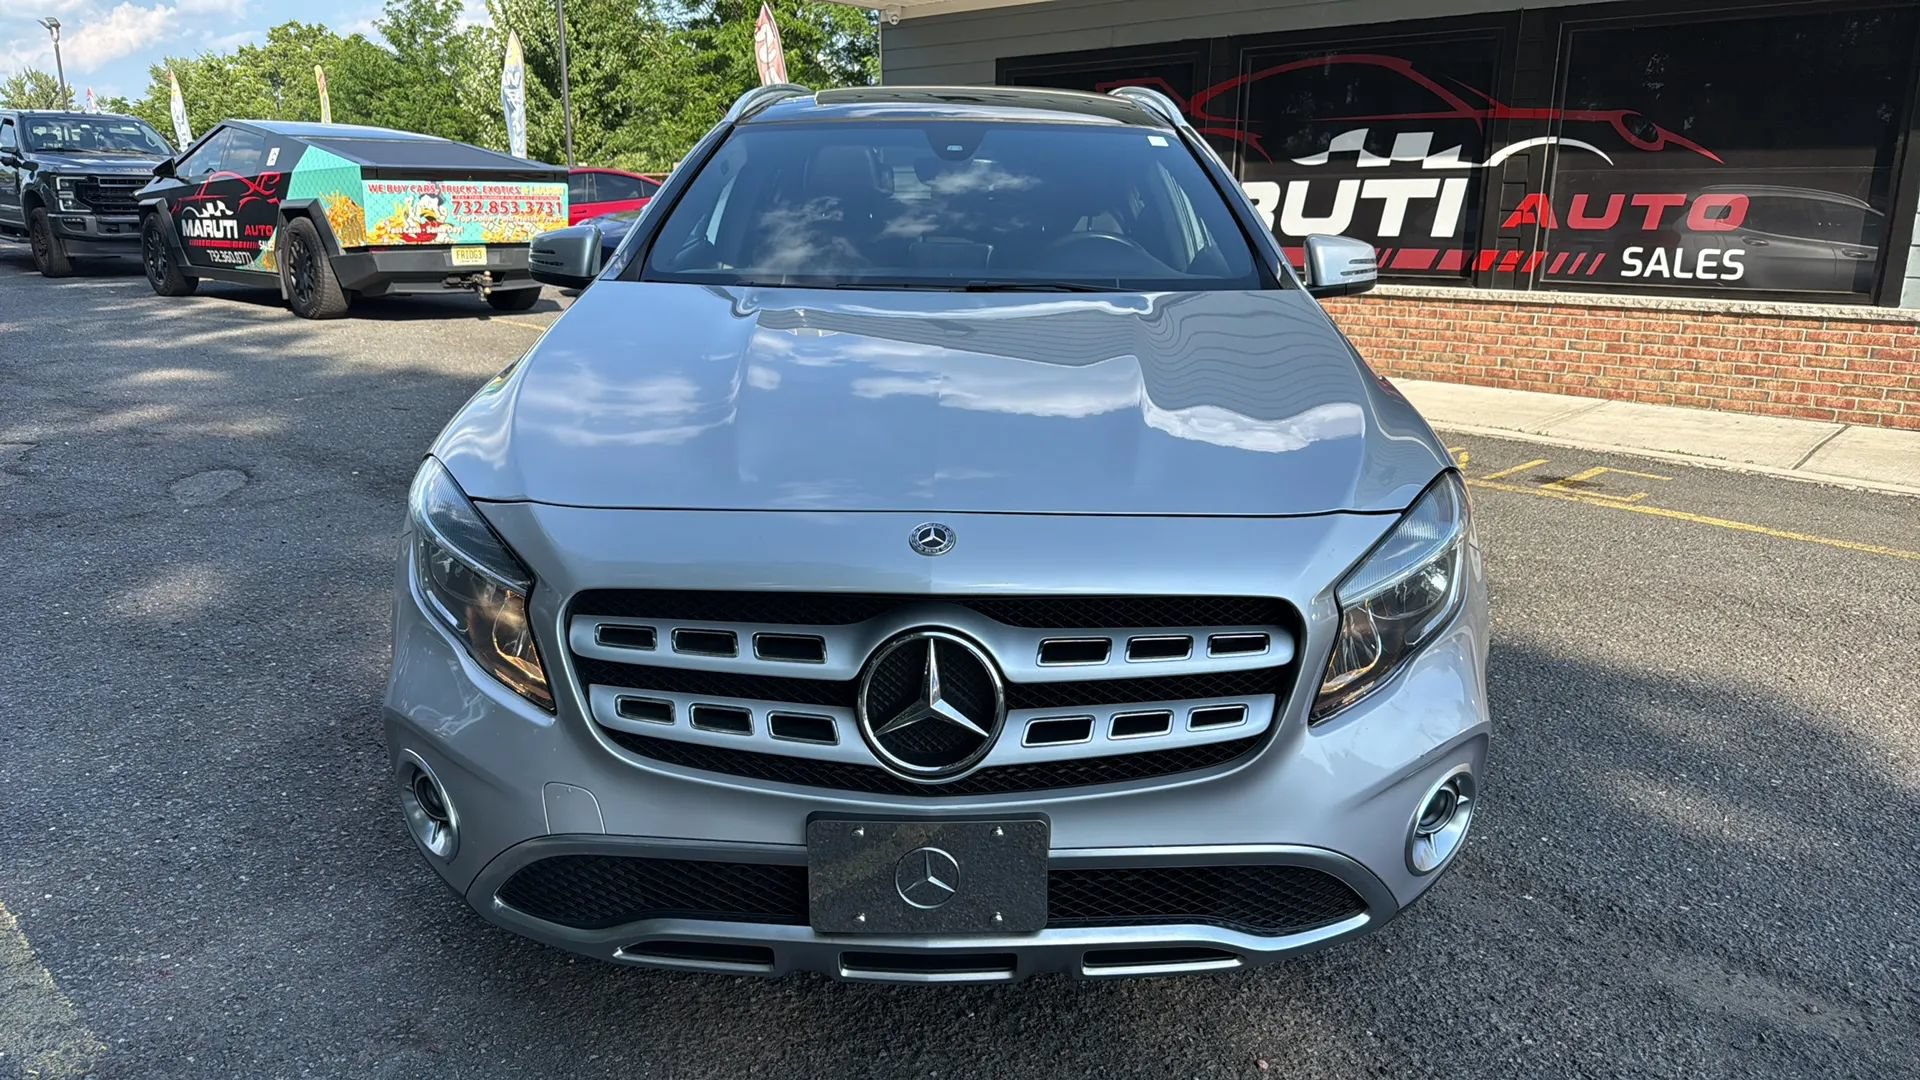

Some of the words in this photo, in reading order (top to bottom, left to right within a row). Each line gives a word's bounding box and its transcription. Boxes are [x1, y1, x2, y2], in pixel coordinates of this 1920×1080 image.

[368, 184, 385, 194] WE
[386, 184, 409, 194] BUY
[452, 200, 562, 216] 732.853.3731
[1241, 178, 1469, 238] UTI
[1501, 193, 1750, 231] AUTO
[181, 219, 239, 239] MARUTI
[244, 225, 273, 237] AUTO
[456, 249, 482, 259] FRIDG3
[1620, 246, 1746, 281] SALES
